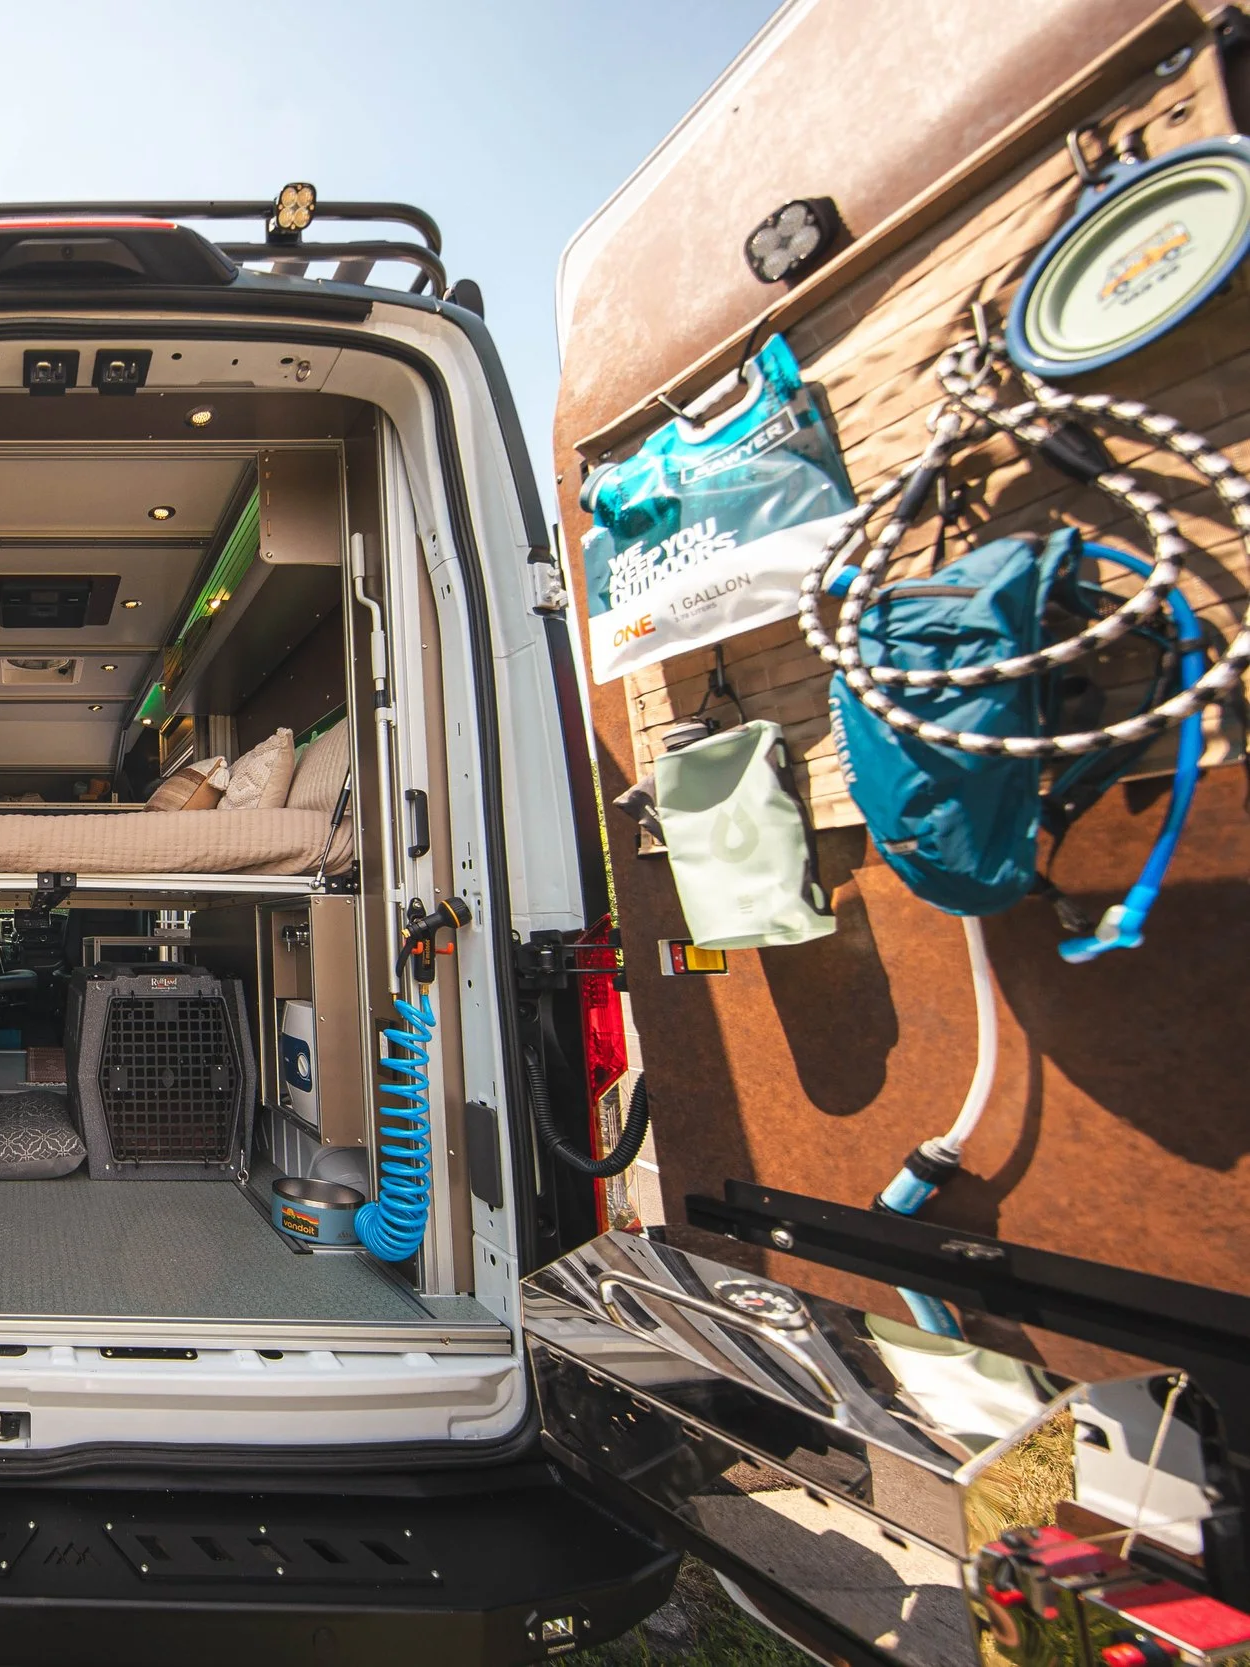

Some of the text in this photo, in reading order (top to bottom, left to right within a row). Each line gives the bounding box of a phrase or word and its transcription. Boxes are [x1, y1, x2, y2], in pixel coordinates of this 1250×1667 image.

[693, 421, 785, 477] SAWYER
[608, 540, 645, 575] WE
[610, 516, 717, 594] KEEP YOU
[669, 572, 752, 615] 1 GALLON
[613, 613, 657, 648] ONE
[283, 1219, 316, 1236] vandoit
